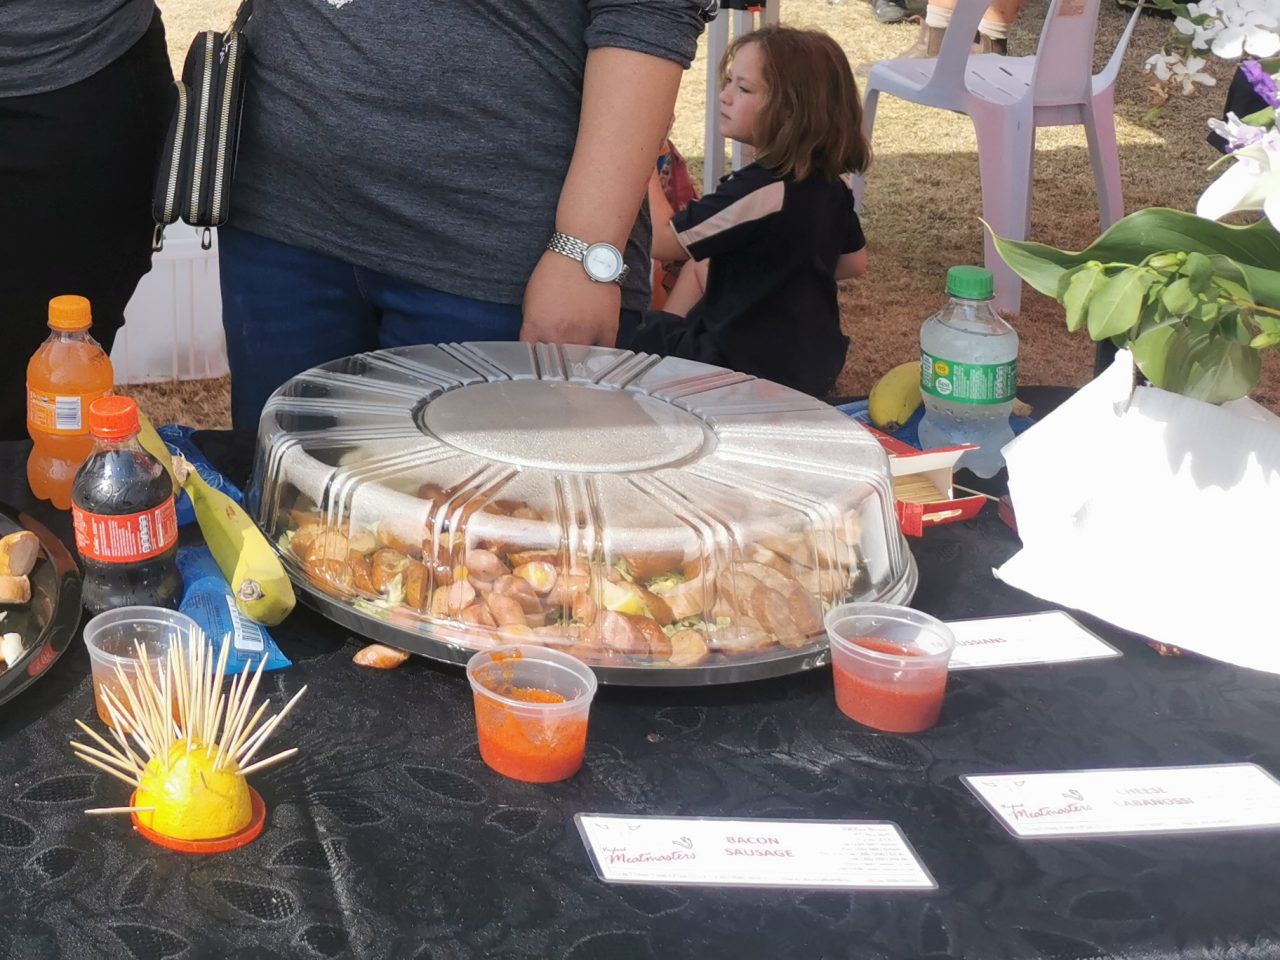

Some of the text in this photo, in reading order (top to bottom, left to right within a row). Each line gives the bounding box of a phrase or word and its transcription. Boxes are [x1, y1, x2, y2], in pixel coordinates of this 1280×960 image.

[954, 637, 1007, 647] USSIANS
[726, 836, 781, 846] BACON
[607, 851, 696, 865] Meatmasters
[724, 848, 795, 858] SAUSAGE
